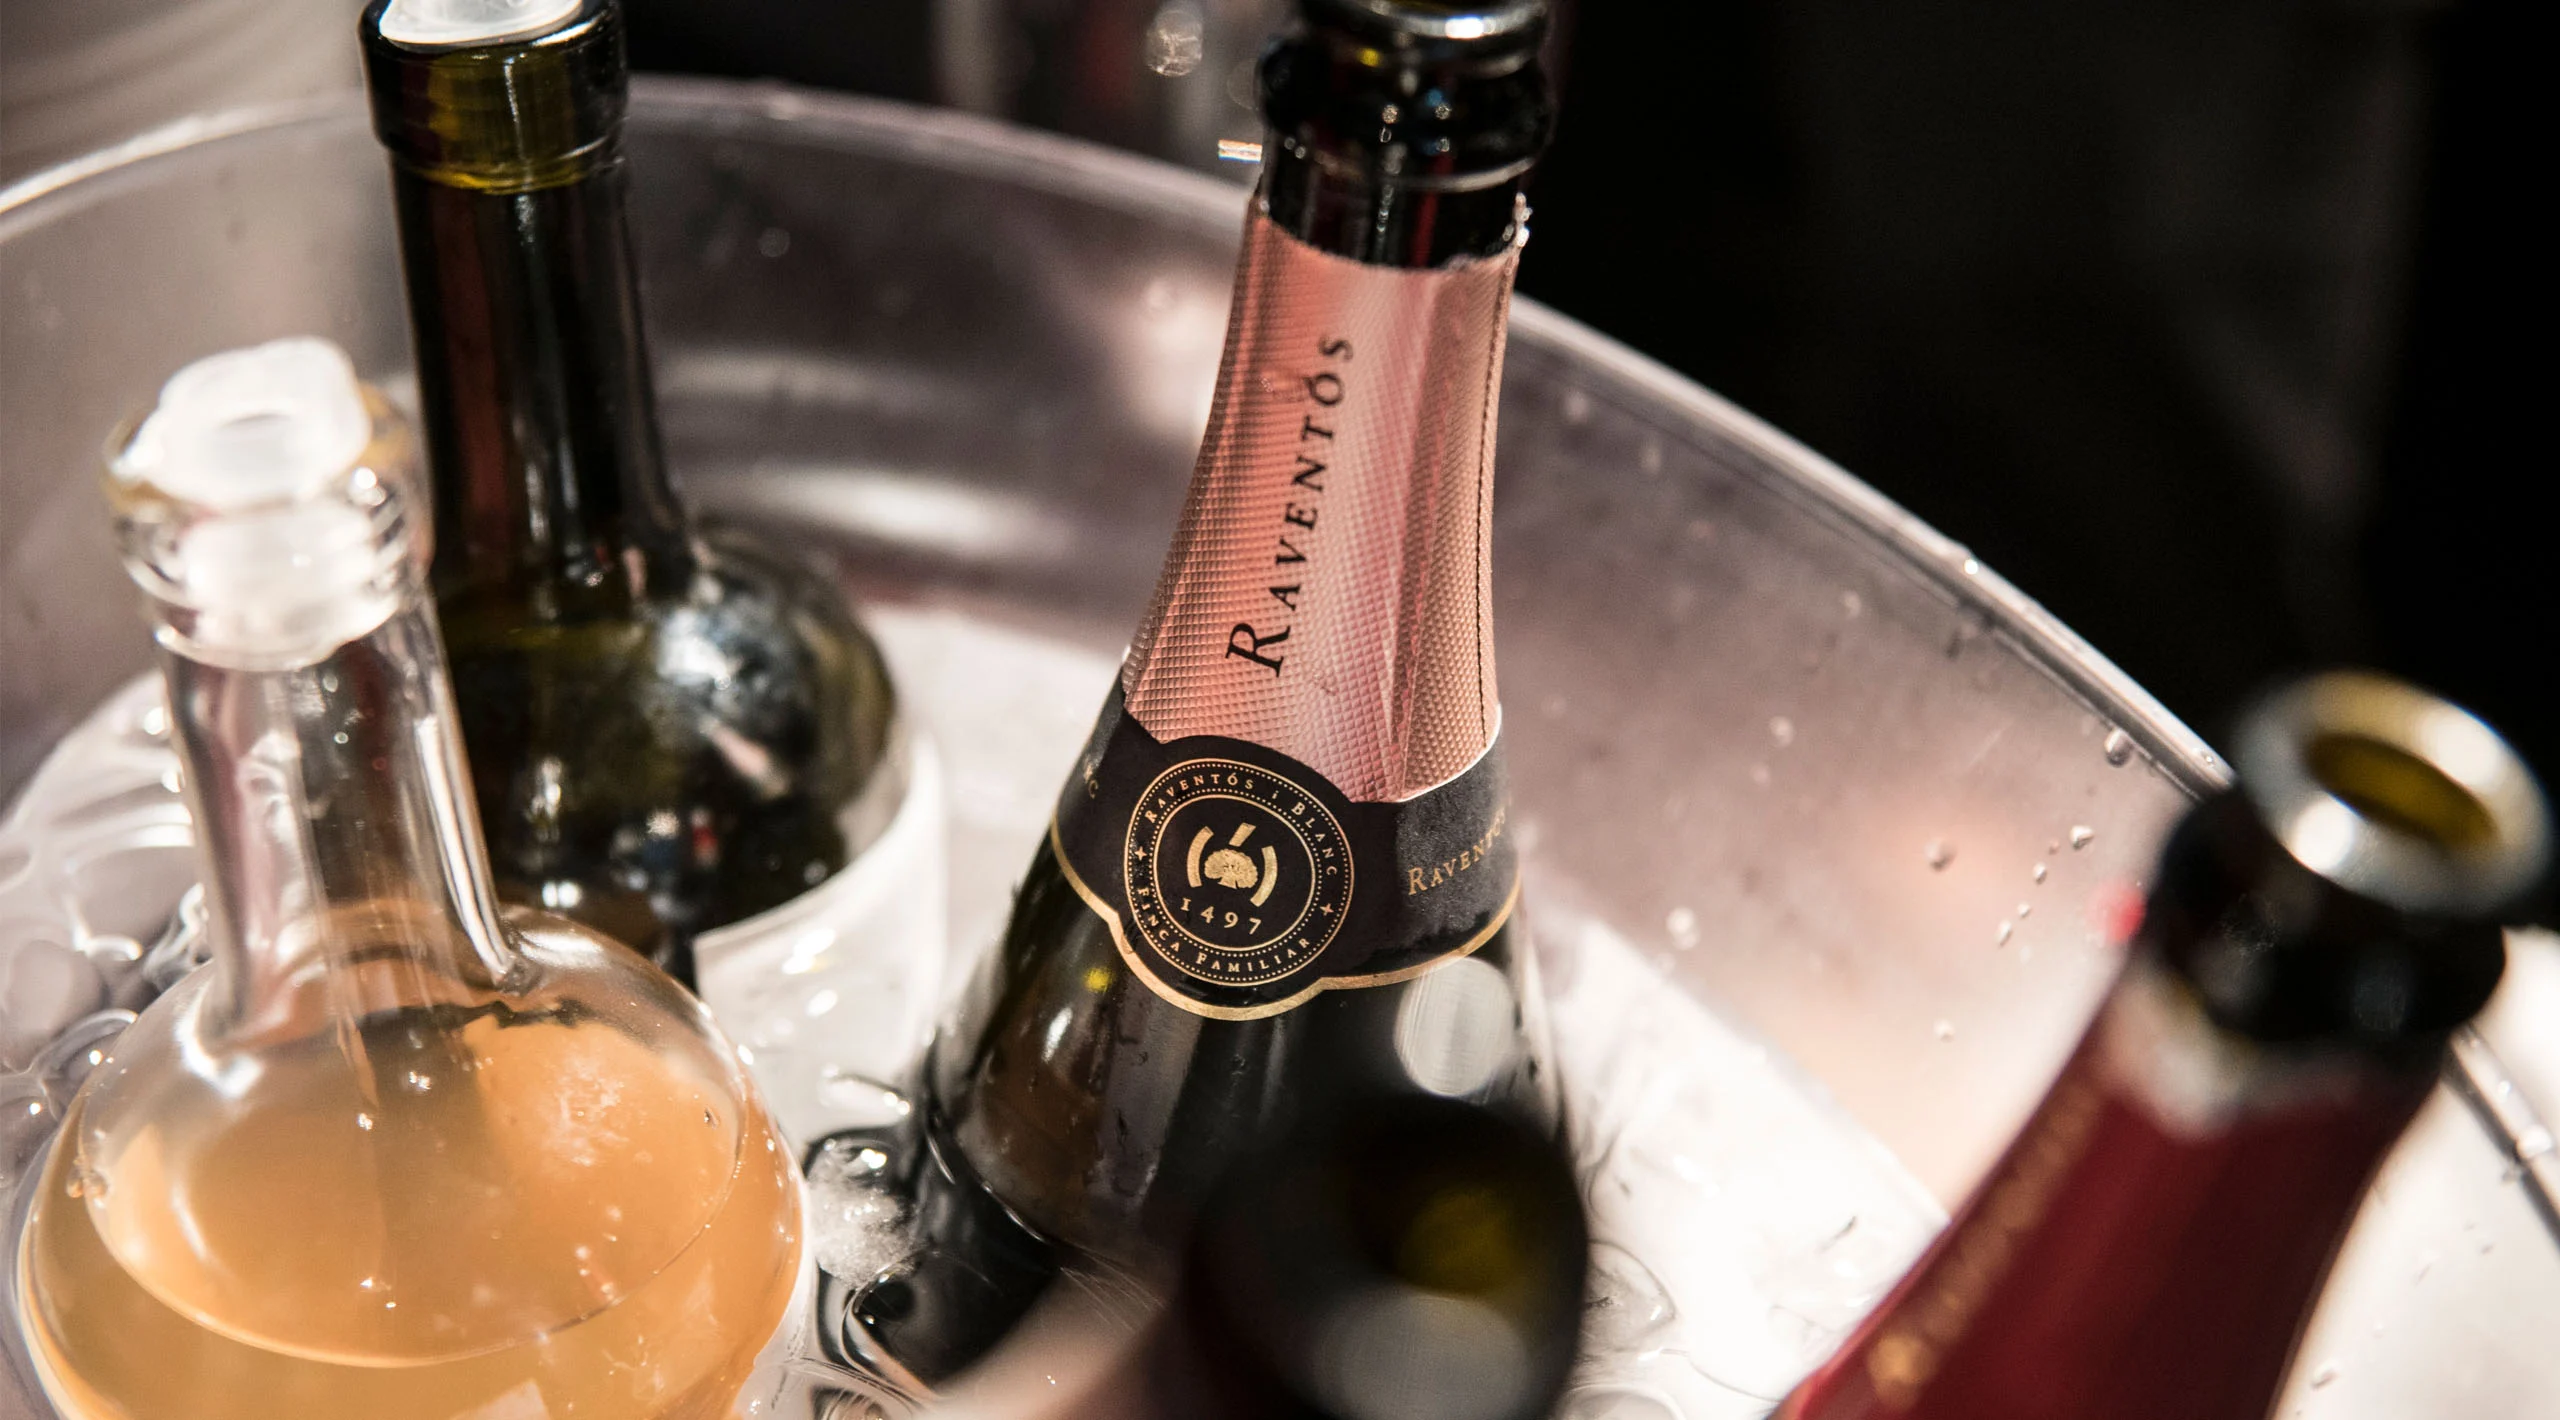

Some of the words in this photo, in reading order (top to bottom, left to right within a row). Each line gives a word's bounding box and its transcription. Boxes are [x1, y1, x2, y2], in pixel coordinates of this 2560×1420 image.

[1144, 771, 1255, 824] RAVENTÓS
[1290, 801, 1339, 877] BLANC
[1137, 886, 1181, 952] FINCA
[1195, 937, 1311, 973] FAMILIAR
[1180, 896, 1263, 936] 1497
